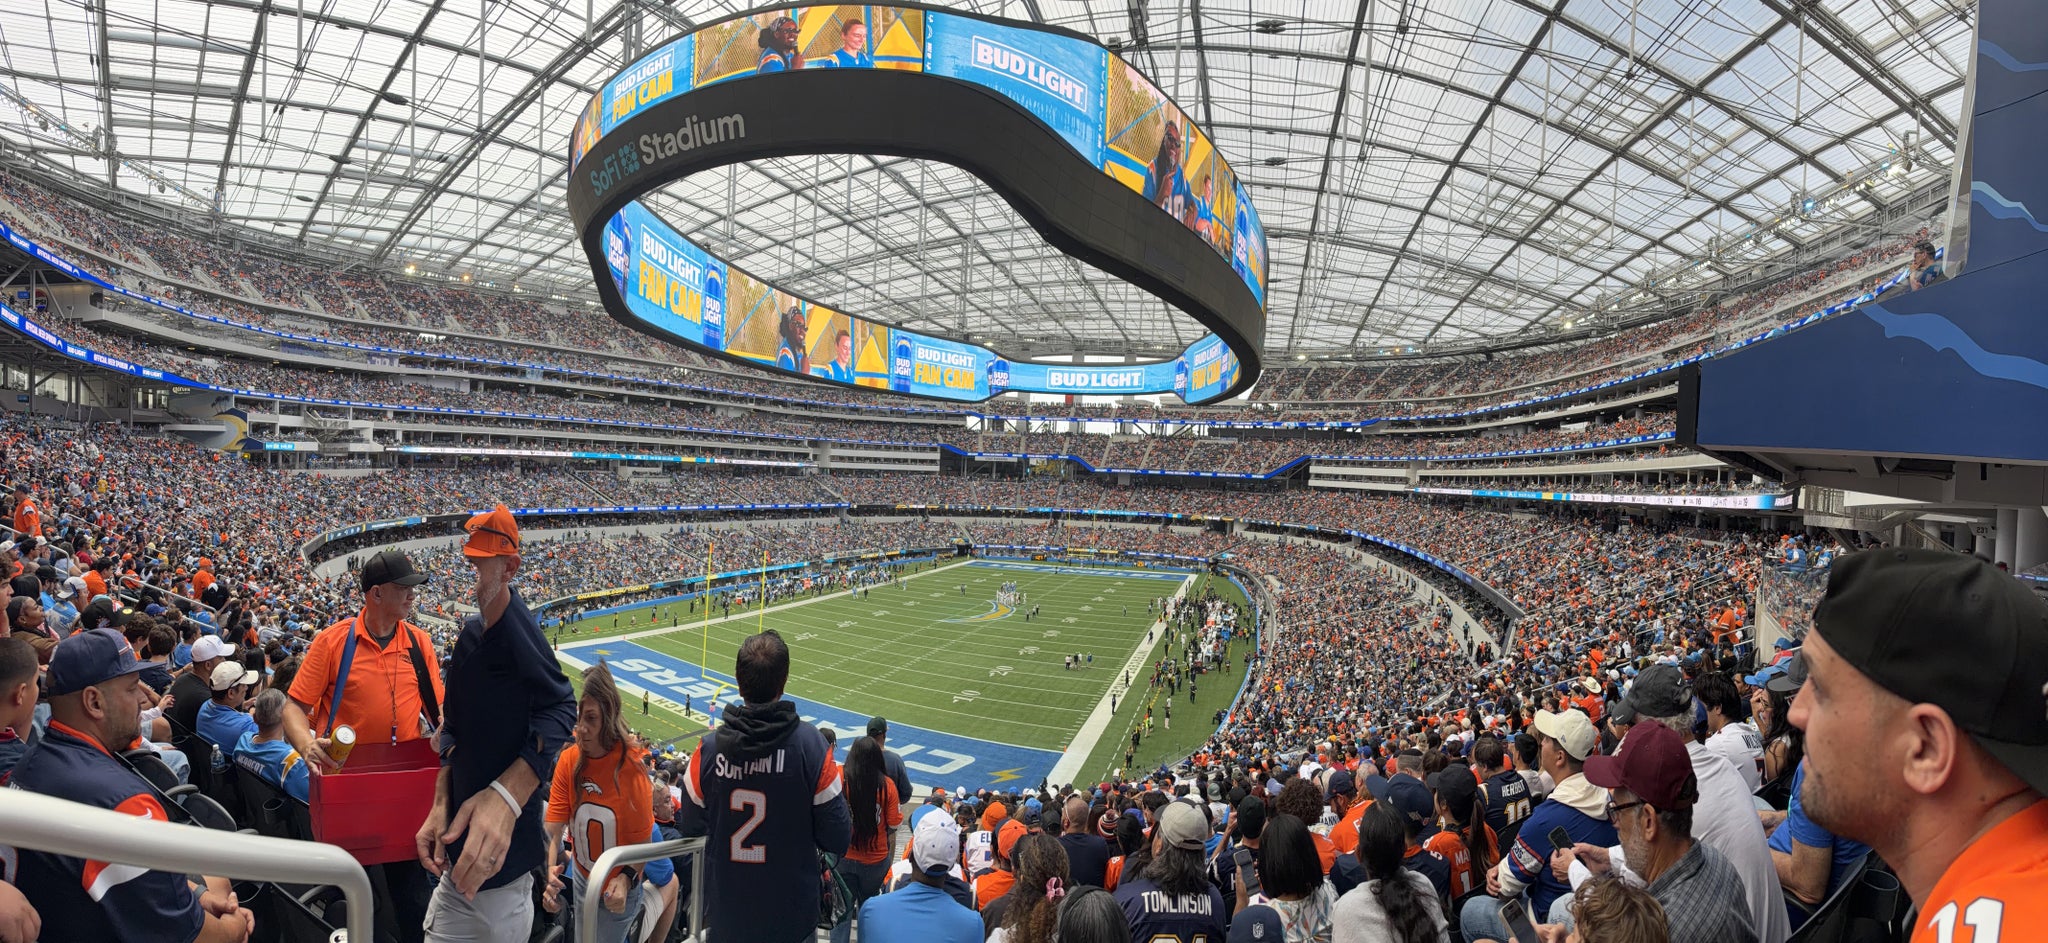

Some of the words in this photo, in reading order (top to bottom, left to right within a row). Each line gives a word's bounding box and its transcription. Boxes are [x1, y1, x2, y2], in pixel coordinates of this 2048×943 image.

[615, 74, 636, 98] BUD
[637, 53, 672, 83] LIGHT
[976, 41, 1026, 76] BUD
[1028, 62, 1084, 105] LIGHT
[612, 88, 637, 124] FAN
[638, 69, 673, 106] CAM
[590, 152, 622, 197] SoFi
[639, 111, 746, 165] Stadium
[642, 231, 667, 265] BUD
[667, 250, 701, 285] LIGHT
[638, 259, 667, 309] FAN
[669, 280, 702, 325] CAM
[705, 295, 721, 313] BUD
[895, 357, 911, 368] BUD
[917, 347, 941, 362] BUD
[941, 353, 974, 367] LIGHT
[914, 362, 941, 385] FAN
[943, 367, 975, 391] CAM
[1050, 372, 1089, 387] BUD
[1092, 372, 1142, 387] LIGHT
[775, 749, 786, 773] II
[729, 788, 767, 864] 2
[1141, 890, 1212, 917] TOMLINSON
